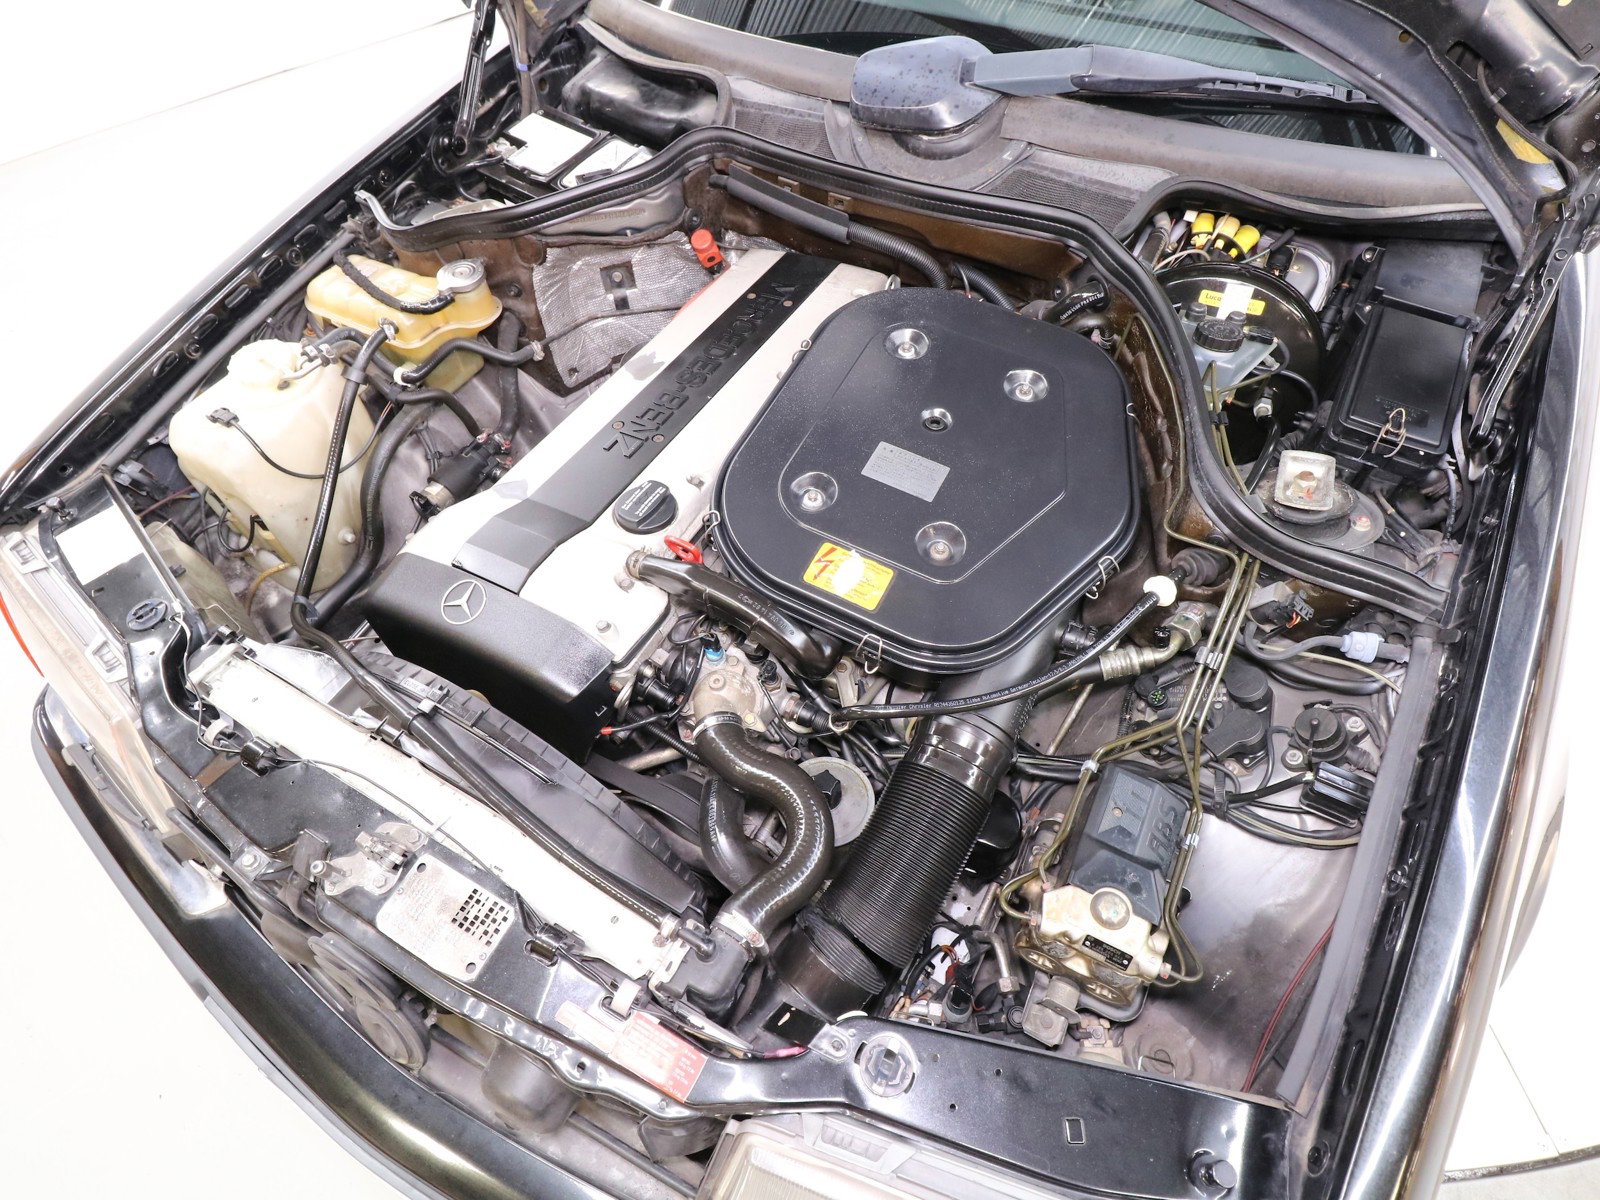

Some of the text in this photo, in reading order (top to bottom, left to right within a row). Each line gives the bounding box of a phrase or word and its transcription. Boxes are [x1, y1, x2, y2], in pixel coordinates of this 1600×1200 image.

[1205, 292, 1222, 302] Luca
[603, 282, 799, 459] MERCEDES-BENZ
[1146, 796, 1178, 862] ABS
